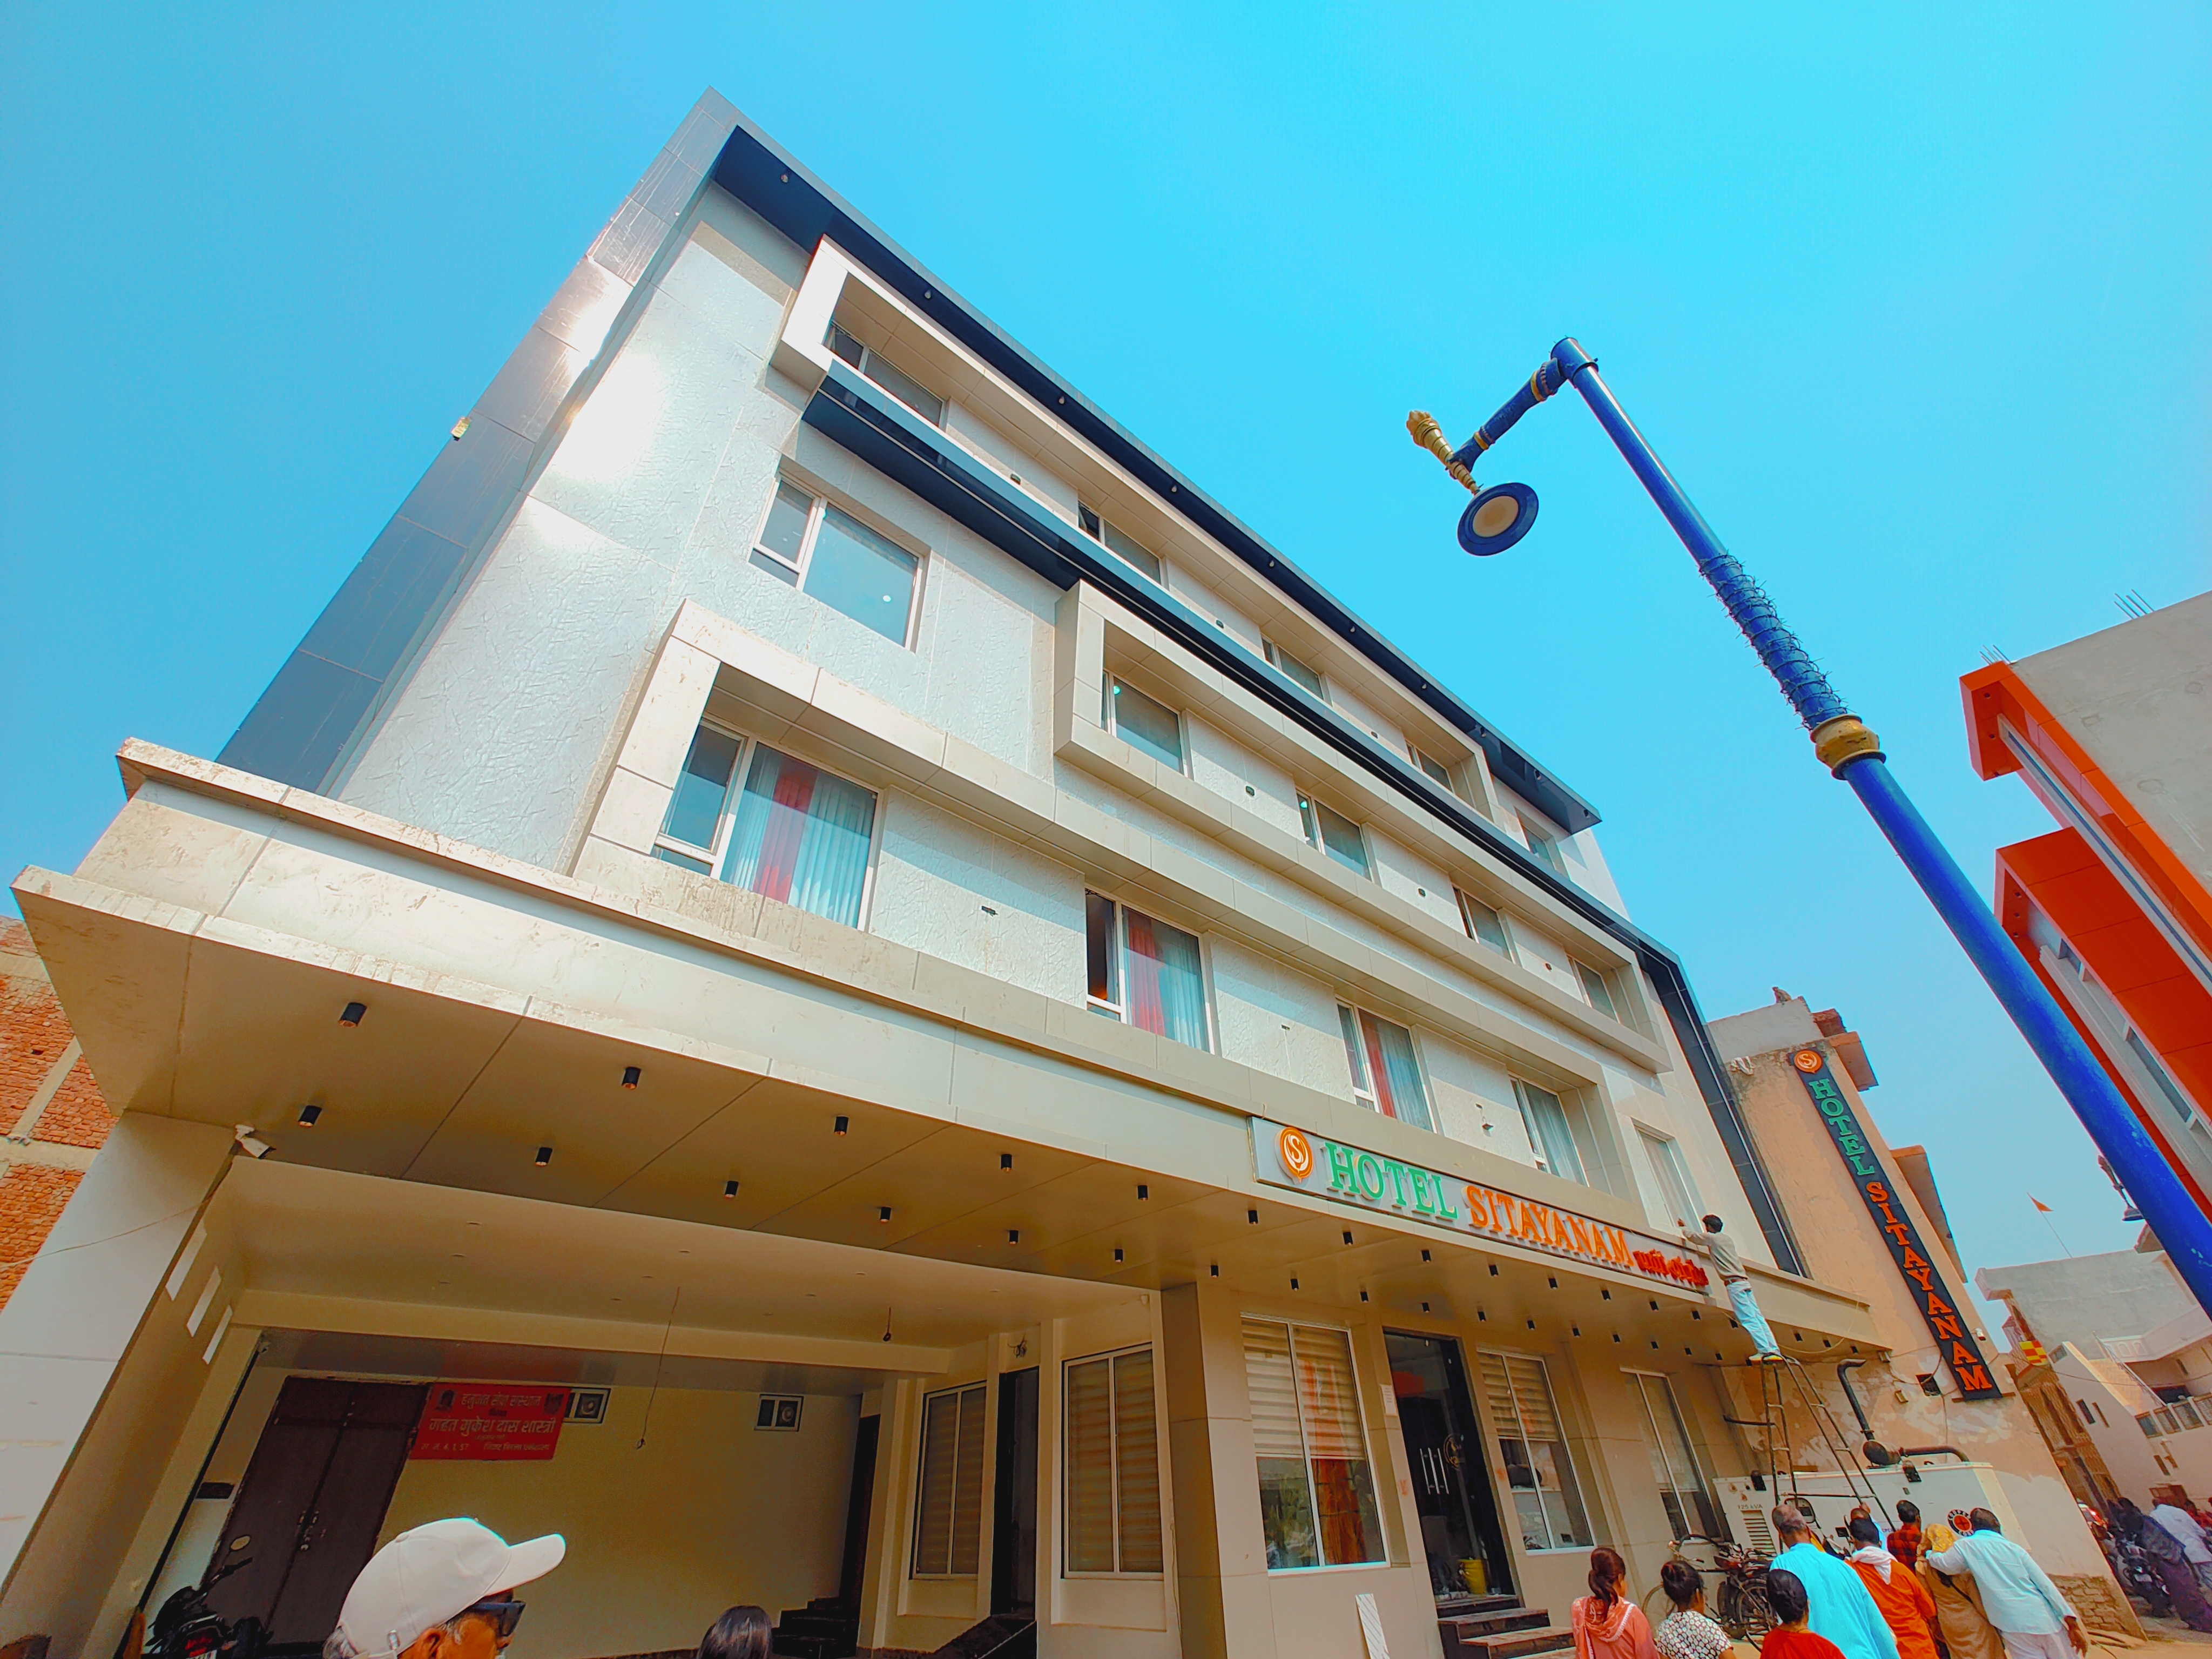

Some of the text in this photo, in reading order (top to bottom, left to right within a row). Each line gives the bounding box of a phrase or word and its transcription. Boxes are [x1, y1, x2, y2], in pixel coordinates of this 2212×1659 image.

[1323, 1142, 1635, 1266] HOTEL SITAYANAM
[1808, 1078, 1993, 1392] HOTEL SITAYANAM
[429, 1415, 557, 1437] महंत मुकेश दास शास्त्री
